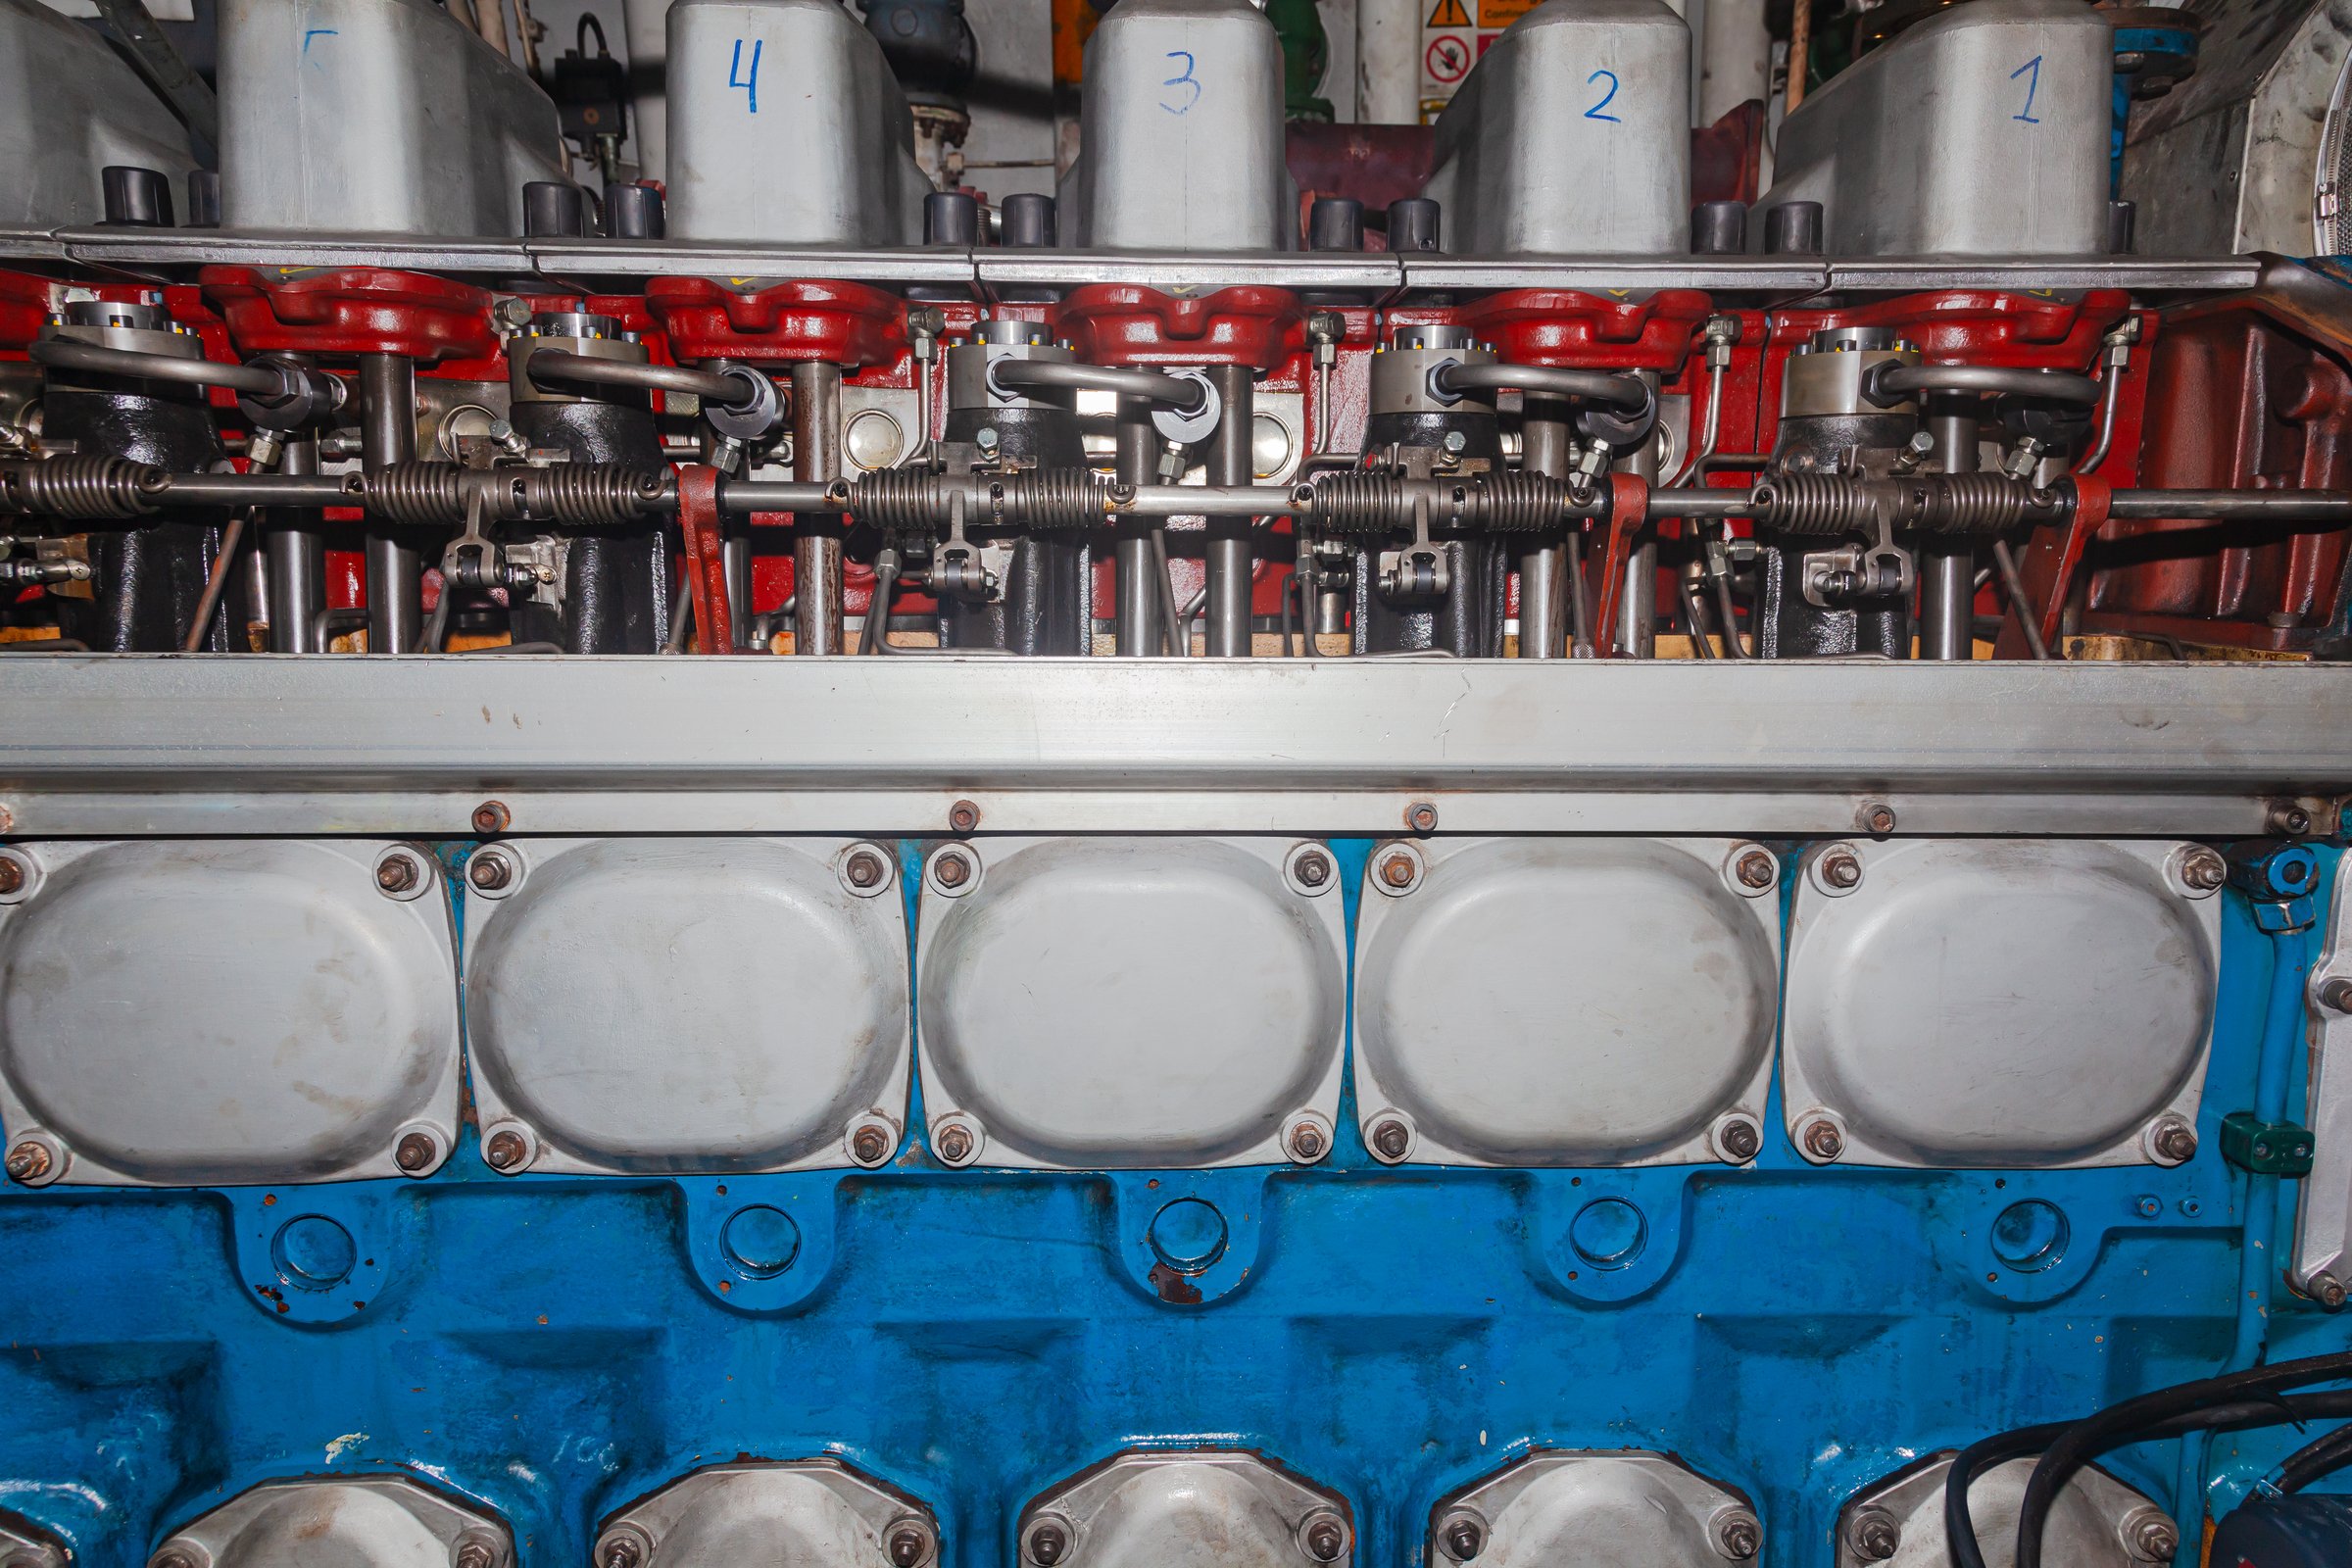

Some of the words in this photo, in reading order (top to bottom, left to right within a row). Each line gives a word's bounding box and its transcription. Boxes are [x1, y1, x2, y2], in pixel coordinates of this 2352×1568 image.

[727, 37, 763, 115] 4
[1159, 51, 1201, 115] 3
[1584, 69, 1622, 123] 2
[2010, 55, 2042, 123] 1
